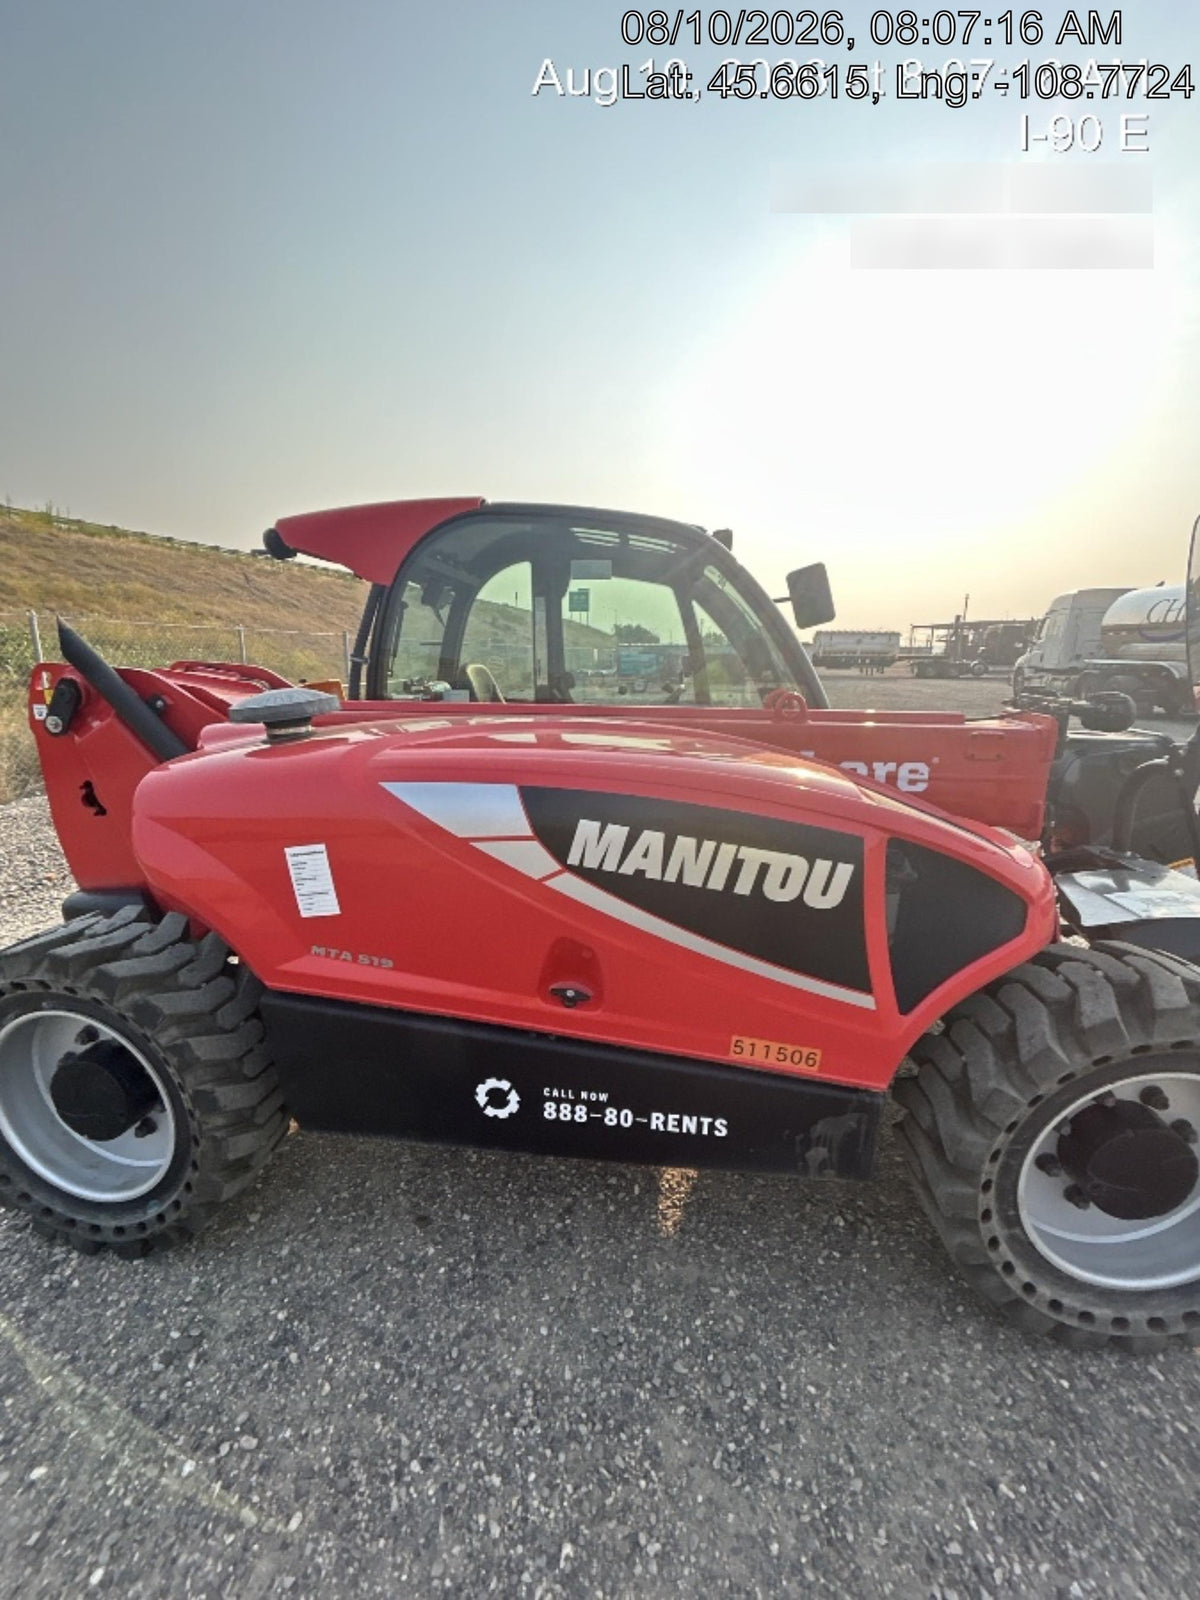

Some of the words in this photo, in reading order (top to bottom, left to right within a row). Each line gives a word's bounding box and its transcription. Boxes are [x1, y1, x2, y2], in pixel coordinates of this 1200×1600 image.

[566, 818, 855, 910] MANITOU
[311, 944, 353, 962] MTA
[358, 953, 394, 969] 519
[733, 1039, 818, 1068] 511506
[543, 1087, 576, 1100] CALL
[580, 1090, 609, 1103] NOW
